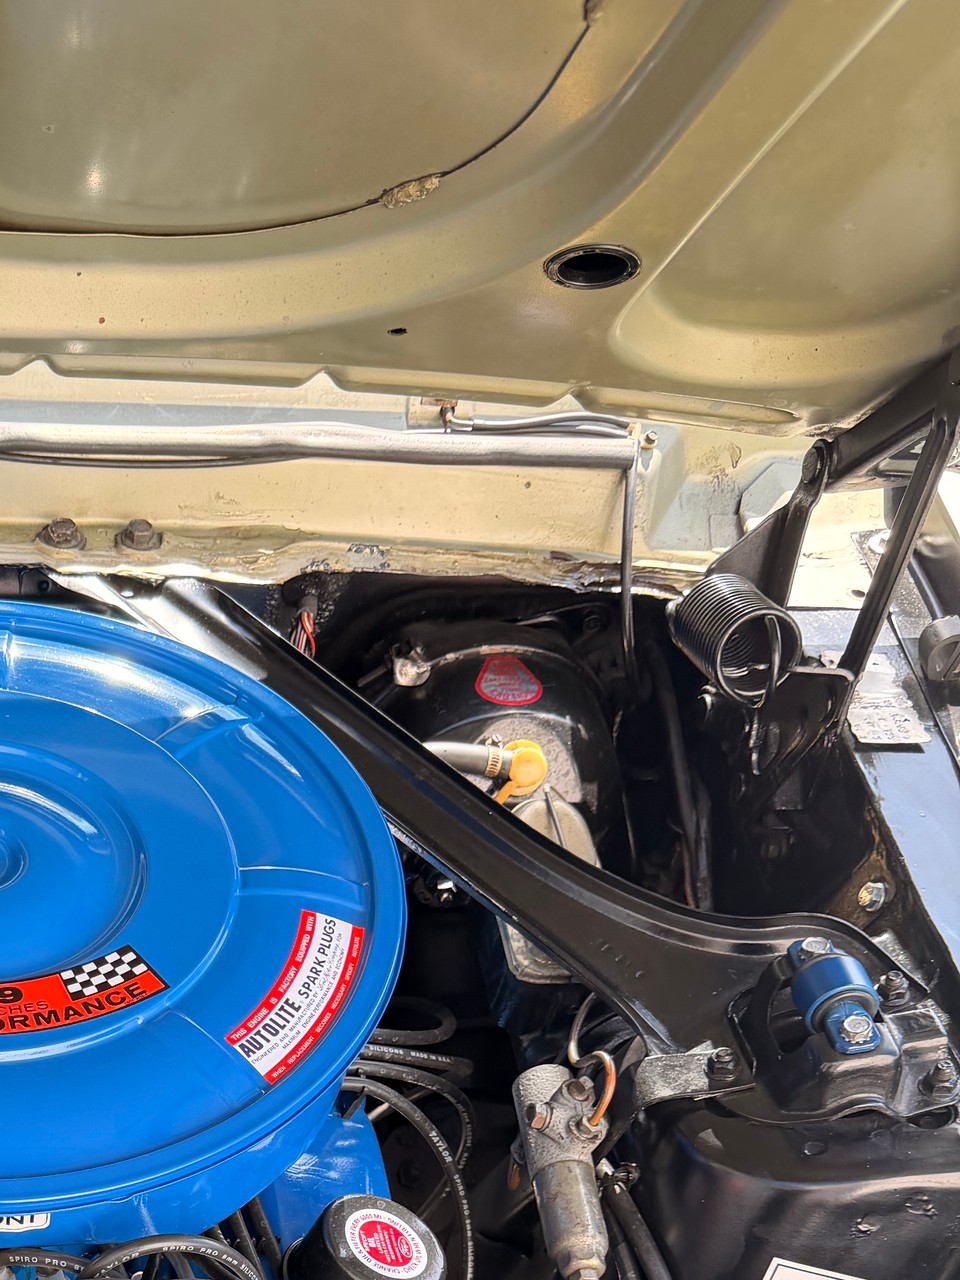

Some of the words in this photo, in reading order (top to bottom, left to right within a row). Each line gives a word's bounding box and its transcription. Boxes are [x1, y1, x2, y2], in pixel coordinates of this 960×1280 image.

[231, 1028, 247, 1041] THIS
[247, 1007, 269, 1029] ENGINE
[270, 997, 278, 1006] IS
[278, 966, 298, 993] FACTORY
[296, 934, 311, 962] EQUIPPED
[305, 916, 314, 932] WITH
[238, 997, 302, 1059] AUTOLITE
[298, 956, 326, 999] SPARK
[318, 918, 337, 961] PLUGS
[272, 1065, 286, 1078] WHEN
[287, 1036, 315, 1065] REPLACEMENT
[315, 1012, 332, 1034] BECOMES
[331, 984, 347, 1010] NECESSARY
[344, 962, 355, 982] SPECIFY
[351, 936, 360, 958] AUTOLITE
[282, 1030, 301, 1050] MAXIMUM
[302, 1012, 316, 1029] ENGINE
[314, 981, 334, 1014] PERFORMANCE
[336, 948, 345, 969] ECONOMY
[251, 1042, 280, 1064] ENGINEERED
[279, 1033, 289, 1043] AND
[289, 998, 315, 1032] MANUFACTURED
[369, 1046, 404, 1055] SILICONE
[410, 1051, 428, 1059] MADE
[350, 1218, 361, 1231] EVERY
[428, 1130, 453, 1163] TAYLOR
[453, 1174, 466, 1197] SPIRO
[462, 1199, 470, 1216] PRO
[467, 1240, 475, 1279] SILICONE
[9, 1255, 38, 1263] SPIRO
[45, 1258, 67, 1268] PRO
[199, 1247, 219, 1257] PRO
[221, 1254, 238, 1266] 8mm
[362, 1254, 372, 1263] OIL
